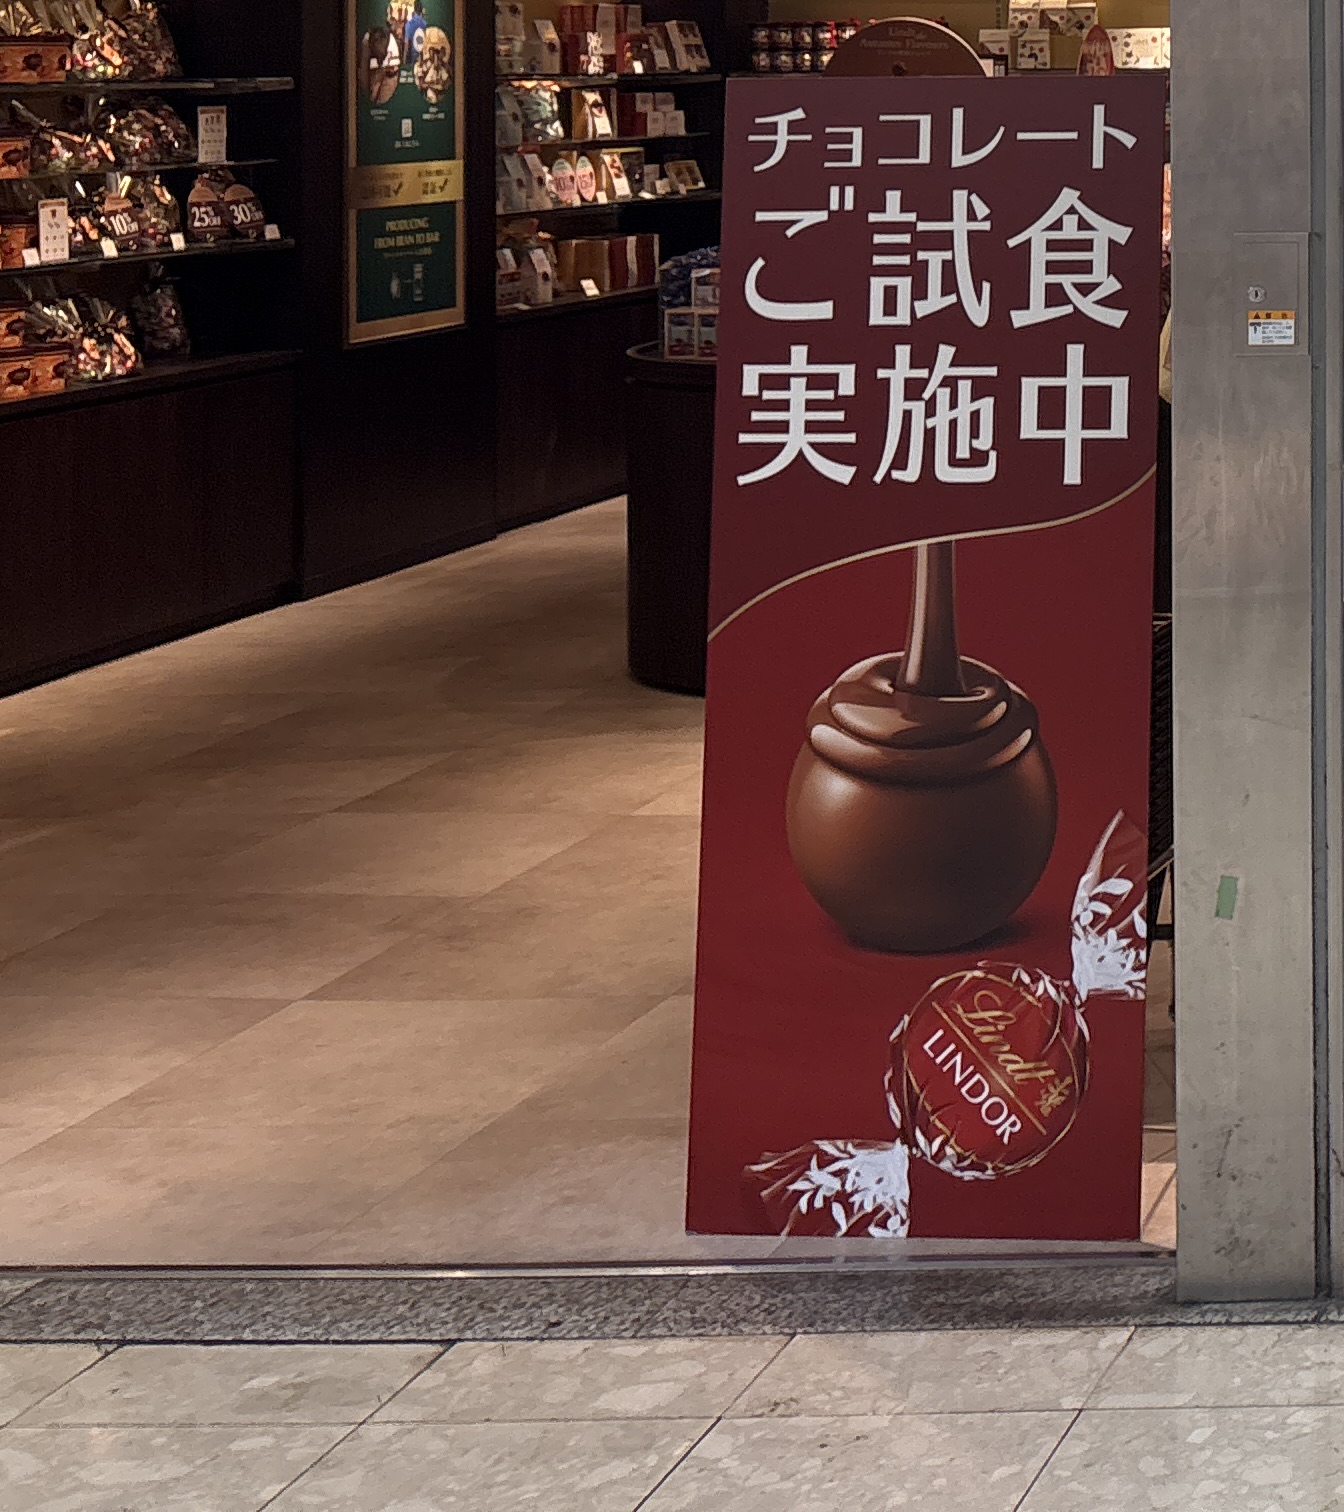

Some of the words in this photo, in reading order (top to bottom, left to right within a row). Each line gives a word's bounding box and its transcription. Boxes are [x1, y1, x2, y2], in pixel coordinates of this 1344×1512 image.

[747, 104, 1138, 172] チョコレート
[744, 185, 1134, 328] ご試食
[737, 343, 1130, 486] 実施中
[922, 1028, 1022, 1145] LINDOR
[952, 990, 1056, 1085] Lindt
